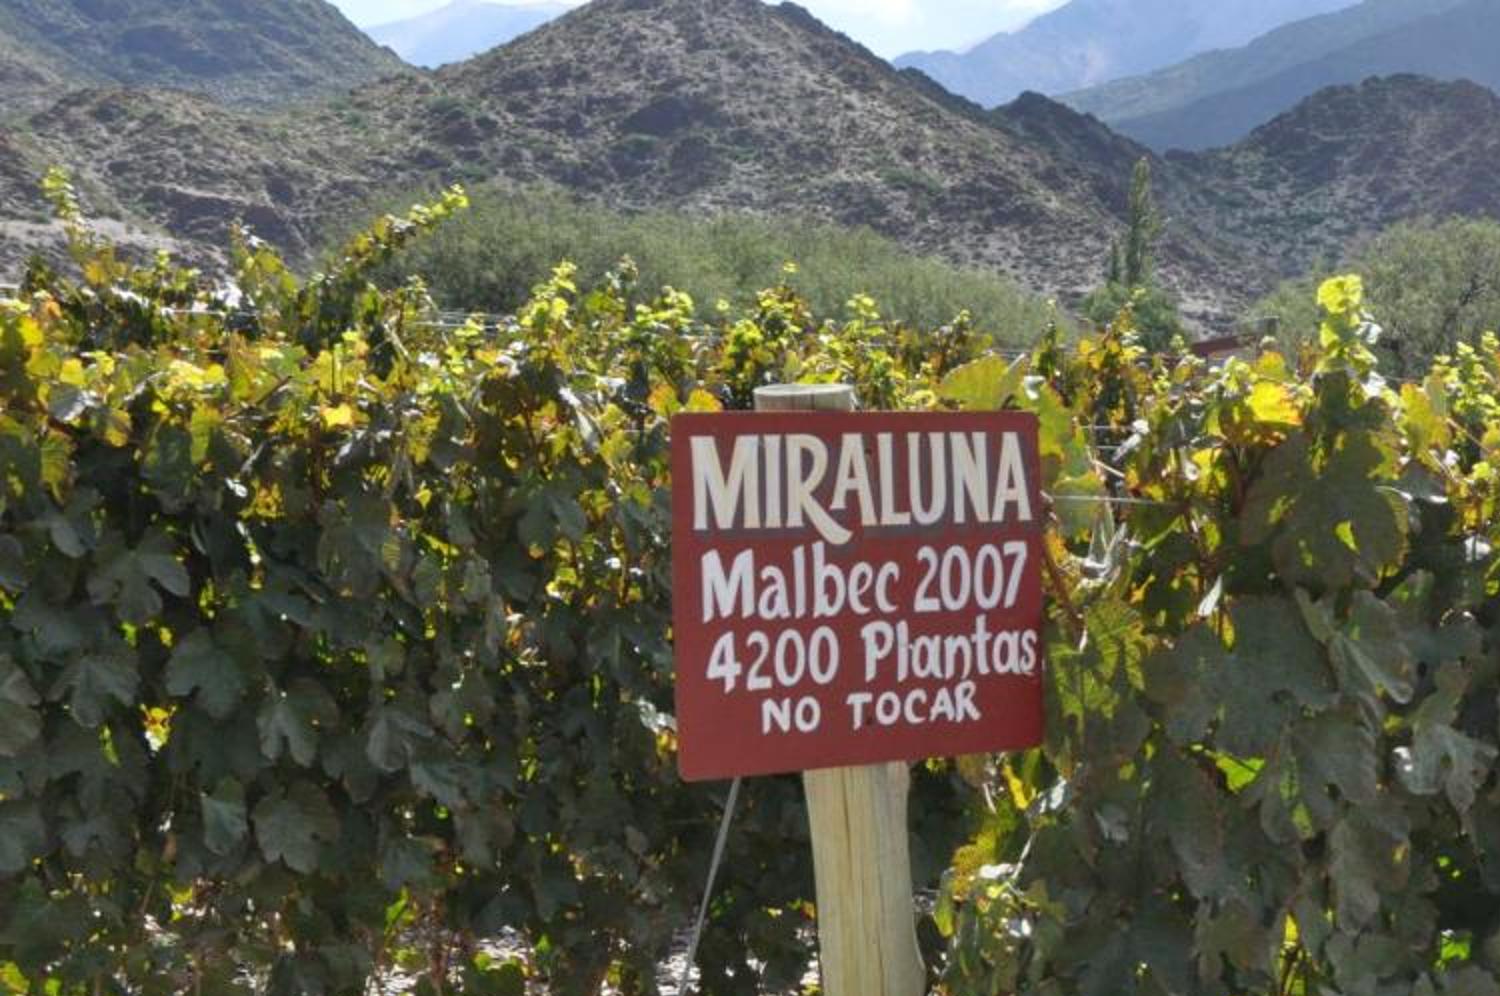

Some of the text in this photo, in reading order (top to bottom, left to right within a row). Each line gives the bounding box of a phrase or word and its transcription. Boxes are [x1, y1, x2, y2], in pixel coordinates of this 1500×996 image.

[689, 431, 1032, 545] MIRALUNA
[701, 540, 1027, 623] Malbec 2007
[706, 617, 1037, 693] 4200 Plantas
[762, 680, 981, 735] NO TOCAR
